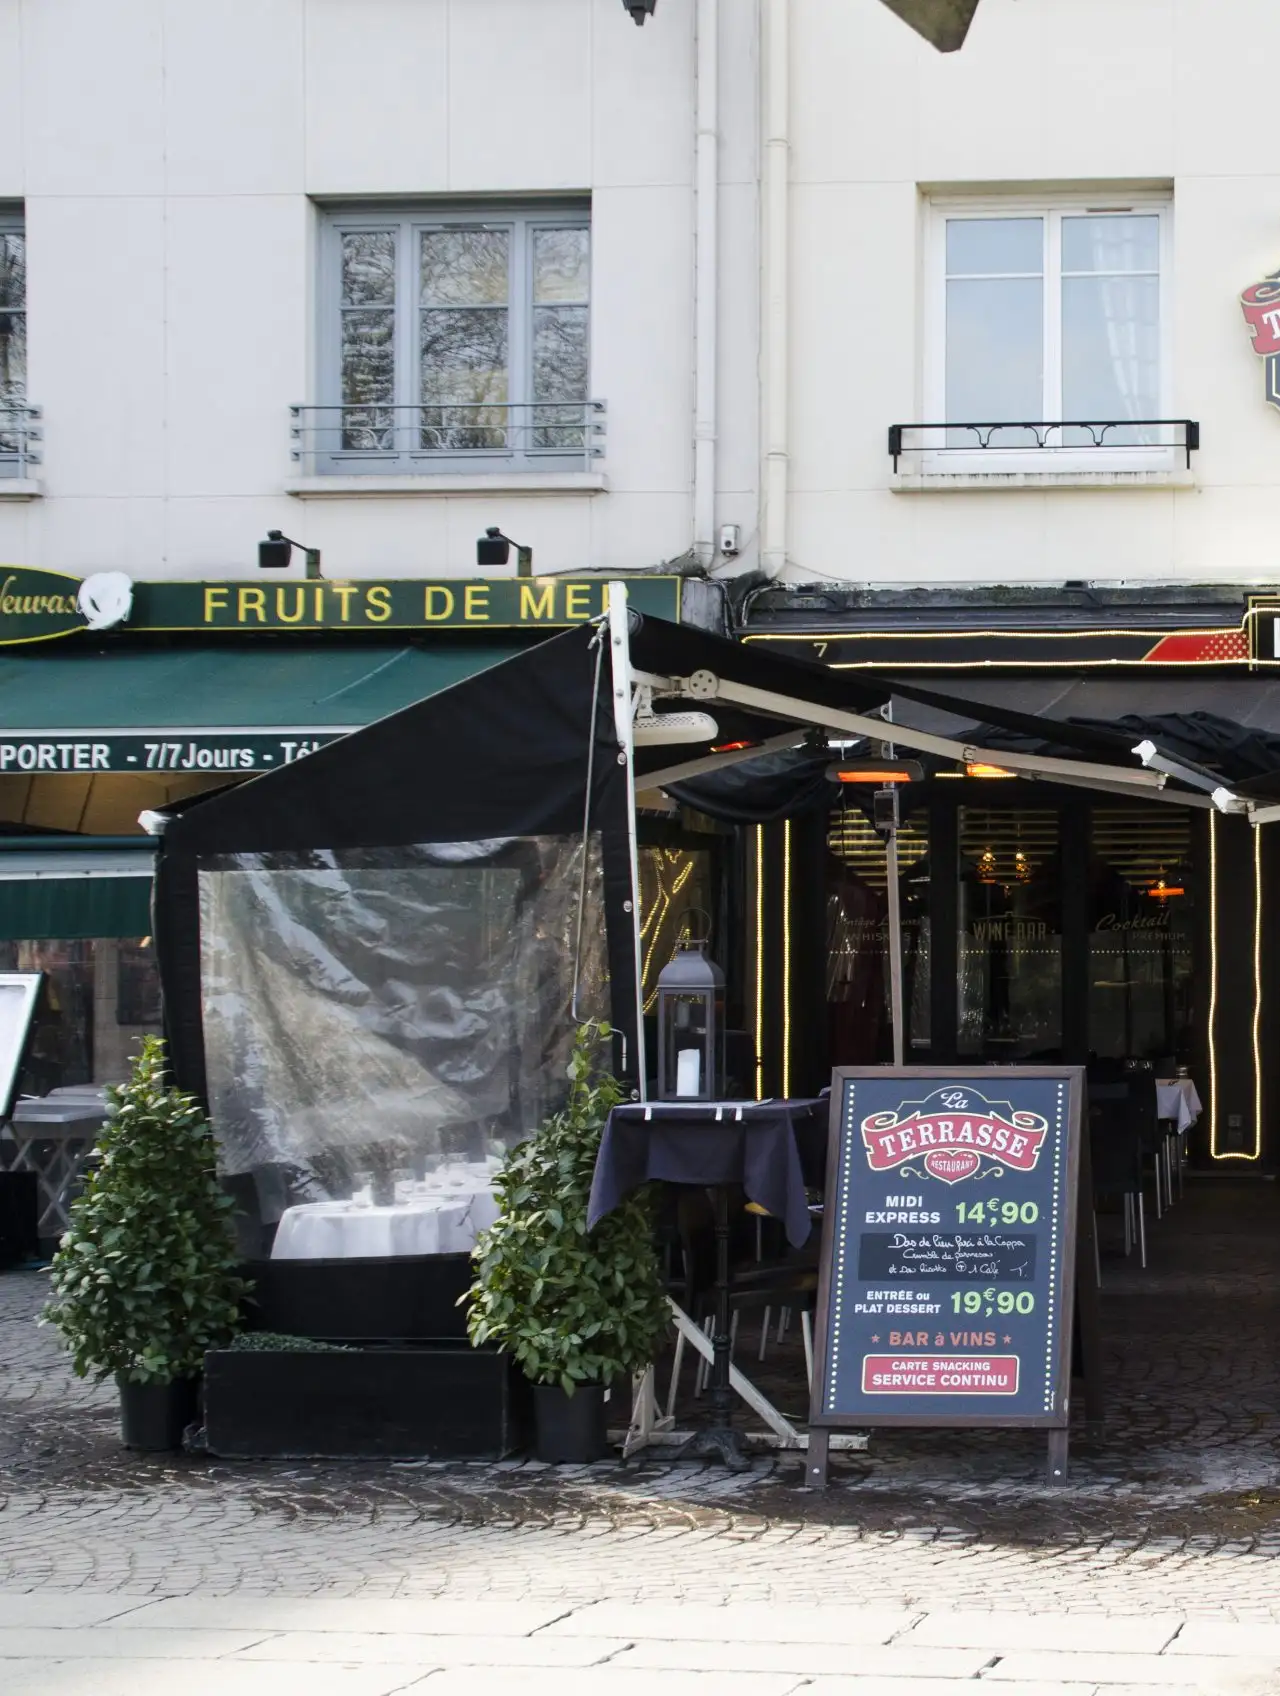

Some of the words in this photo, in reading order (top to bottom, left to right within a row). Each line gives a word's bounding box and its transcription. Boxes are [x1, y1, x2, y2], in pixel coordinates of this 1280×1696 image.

[203, 586, 392, 623] FRUITS
[425, 585, 491, 620] DE
[813, 642, 828, 658] 7
[0, 743, 111, 770] PORTER
[1095, 910, 1171, 933] Cocktail
[973, 921, 1010, 942] WINE
[1017, 921, 1047, 942] BAR
[1132, 931, 1186, 941] PREMIUM
[940, 1092, 968, 1109] La
[879, 1121, 1028, 1158] TERRASSE
[931, 1160, 973, 1173] RESTAURANT
[885, 1196, 923, 1207] MIDI
[865, 1212, 940, 1224] EXPRESS
[866, 1289, 913, 1300] ENTRÉE
[916, 1292, 930, 1300] ou
[854, 1304, 884, 1313] PLAT
[886, 1304, 941, 1314] DESSERT
[889, 1332, 929, 1346] BAR
[934, 1332, 945, 1346] à
[950, 1332, 996, 1346] VINS
[891, 1361, 928, 1371] CARTE
[932, 1361, 991, 1371] SNACKING
[872, 1374, 936, 1386] SERVICE
[940, 1374, 1008, 1386] CONTINU
